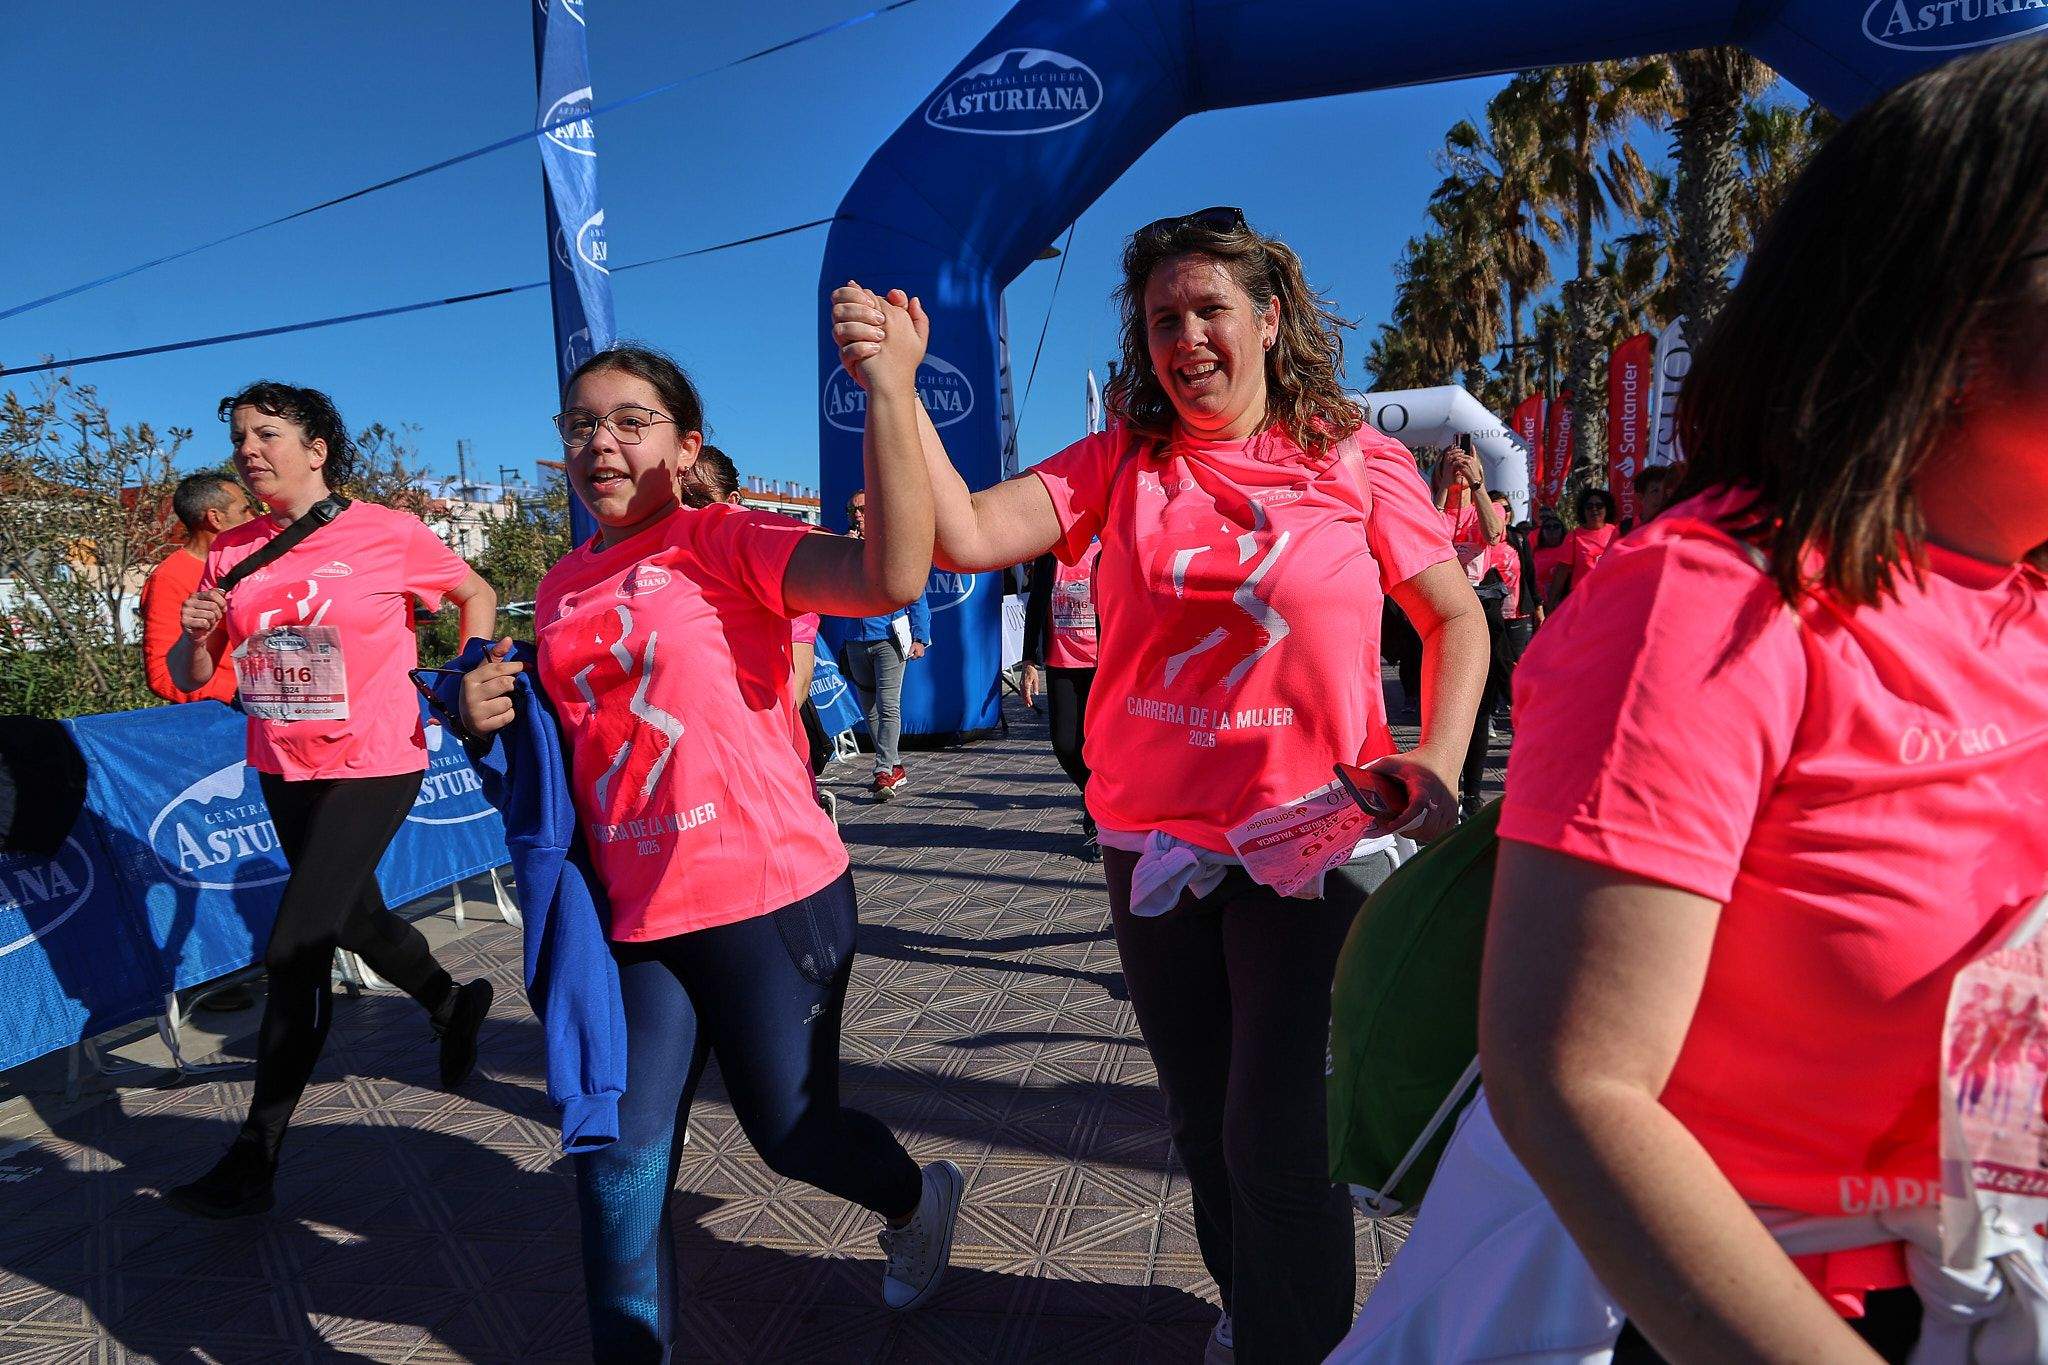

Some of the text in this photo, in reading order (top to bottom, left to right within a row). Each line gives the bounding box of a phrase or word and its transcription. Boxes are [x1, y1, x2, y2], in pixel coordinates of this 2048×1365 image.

[962, 72, 1085, 93] CENTRAL LECHERA
[934, 86, 1090, 121] ASTURIANA
[918, 375, 959, 387] CHERA
[1619, 361, 1639, 454] Santander
[1550, 408, 1573, 477] Santander
[273, 667, 312, 683] 016
[1126, 696, 1294, 730] CARRERA DE LA MUJER
[1189, 729, 1217, 748] 2025
[665, 802, 718, 832] MUJER
[1246, 810, 1296, 833] Santander
[1256, 830, 1295, 848] VALENCIA
